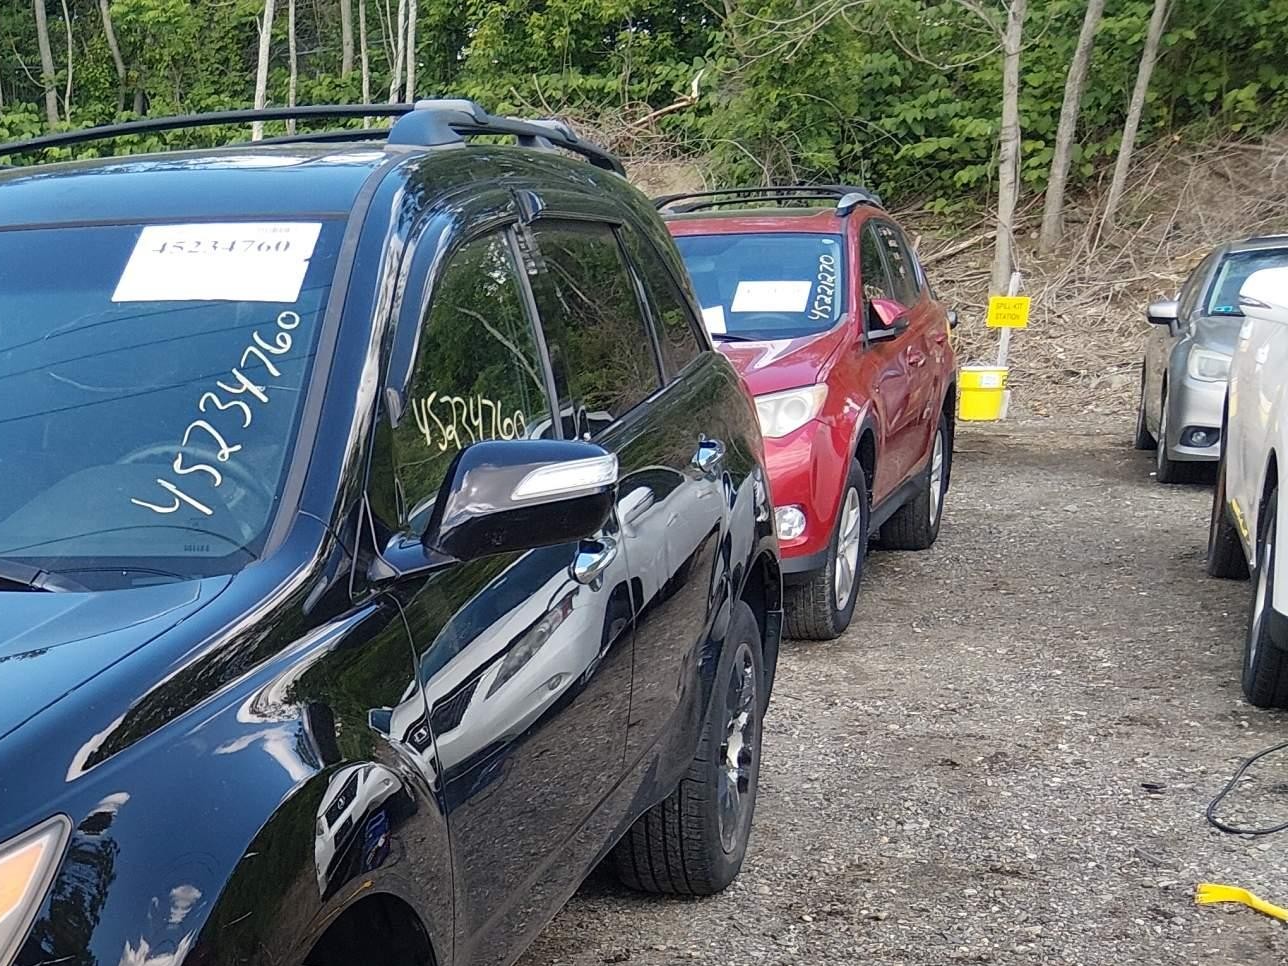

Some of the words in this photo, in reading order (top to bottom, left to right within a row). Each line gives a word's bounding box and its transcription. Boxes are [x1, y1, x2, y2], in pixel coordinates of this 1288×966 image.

[151, 239, 291, 254] 45234760
[808, 254, 836, 321] 45221270
[130, 310, 301, 516] 45234760
[411, 391, 529, 451] 45234760
